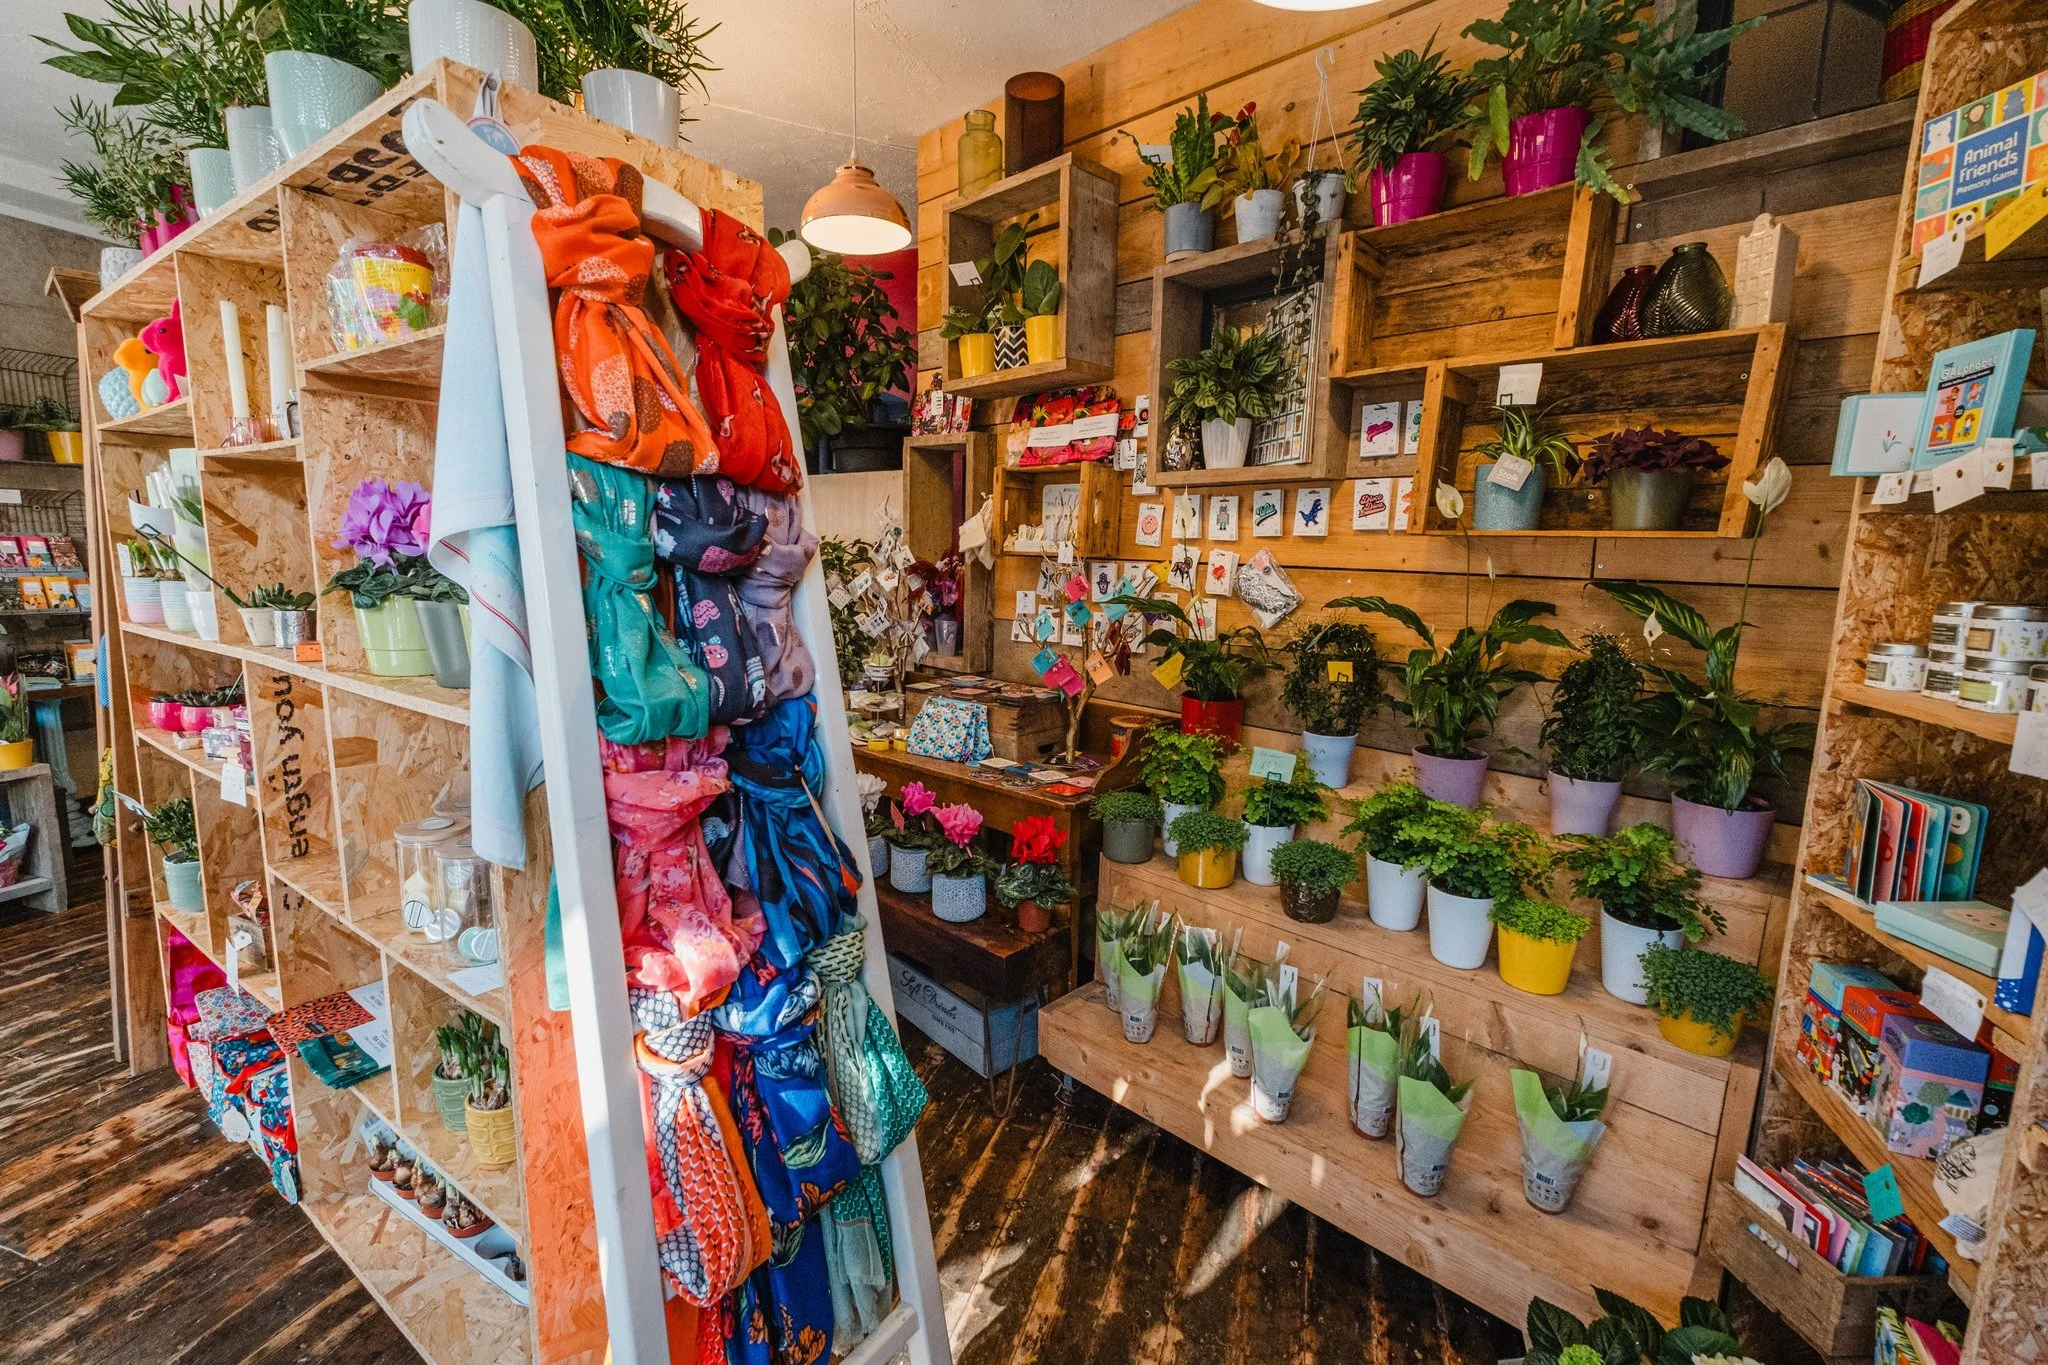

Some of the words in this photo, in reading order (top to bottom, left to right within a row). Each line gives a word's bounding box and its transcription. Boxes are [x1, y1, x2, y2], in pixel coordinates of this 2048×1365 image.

[1963, 131, 2018, 166] Animal
[1956, 177, 1991, 196] Memory
[1991, 169, 2018, 184] Game
[1959, 150, 2018, 184] Friends
[901, 970, 922, 997] Soft
[923, 985, 957, 1019] Drinks
